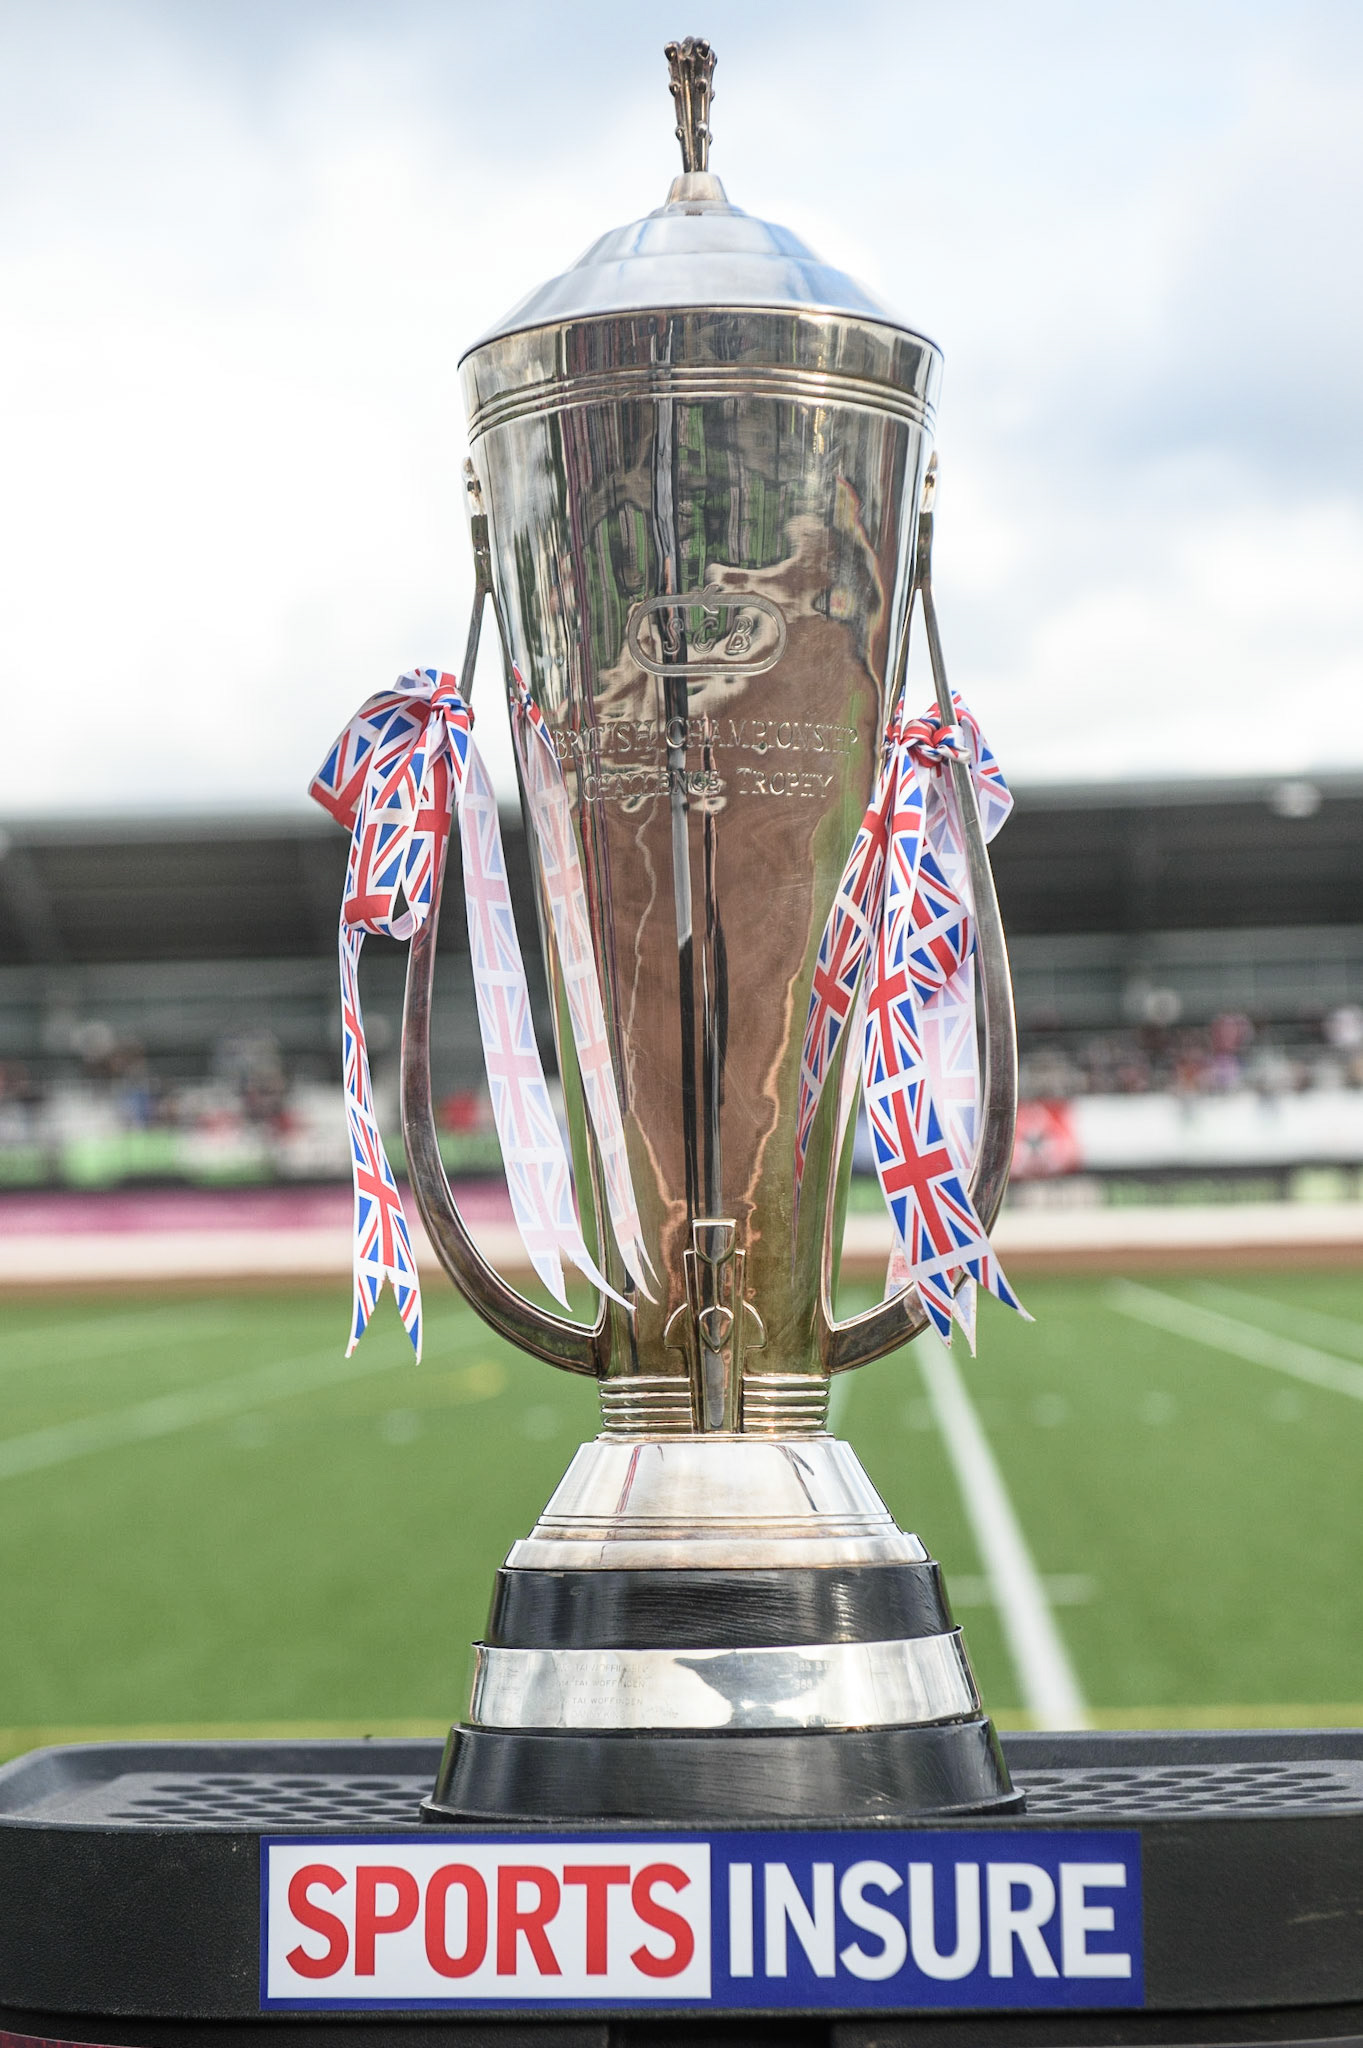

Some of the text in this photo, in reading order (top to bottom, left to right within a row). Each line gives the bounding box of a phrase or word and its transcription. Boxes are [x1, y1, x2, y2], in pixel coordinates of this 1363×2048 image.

[553, 716, 858, 760] BRITISH CHAMPIONSHIP
[582, 767, 835, 801] CHALLENGE TROPHY
[285, 1859, 1132, 1981] SPORTS INSURE
